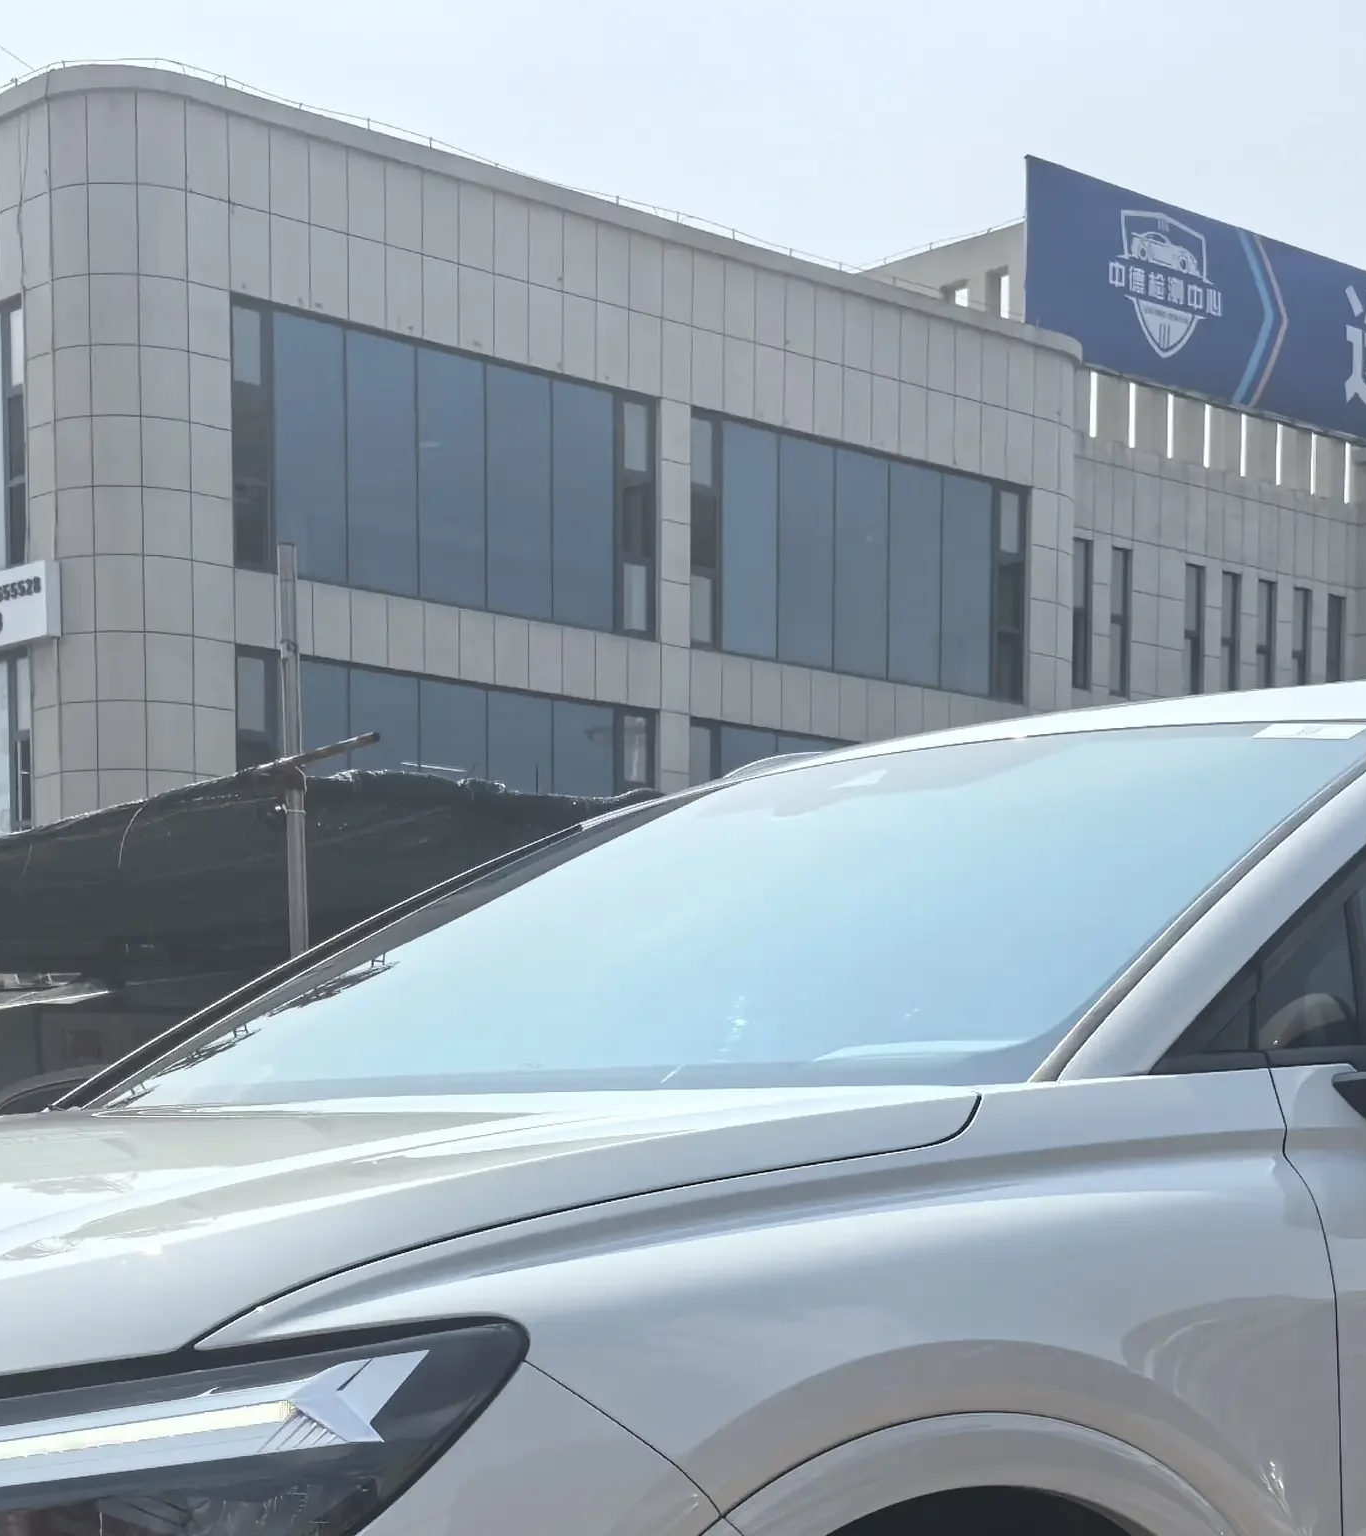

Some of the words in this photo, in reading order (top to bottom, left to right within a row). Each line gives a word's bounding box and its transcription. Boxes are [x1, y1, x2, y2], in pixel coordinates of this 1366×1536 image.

[1109, 260, 1222, 316] 中德检测中心
